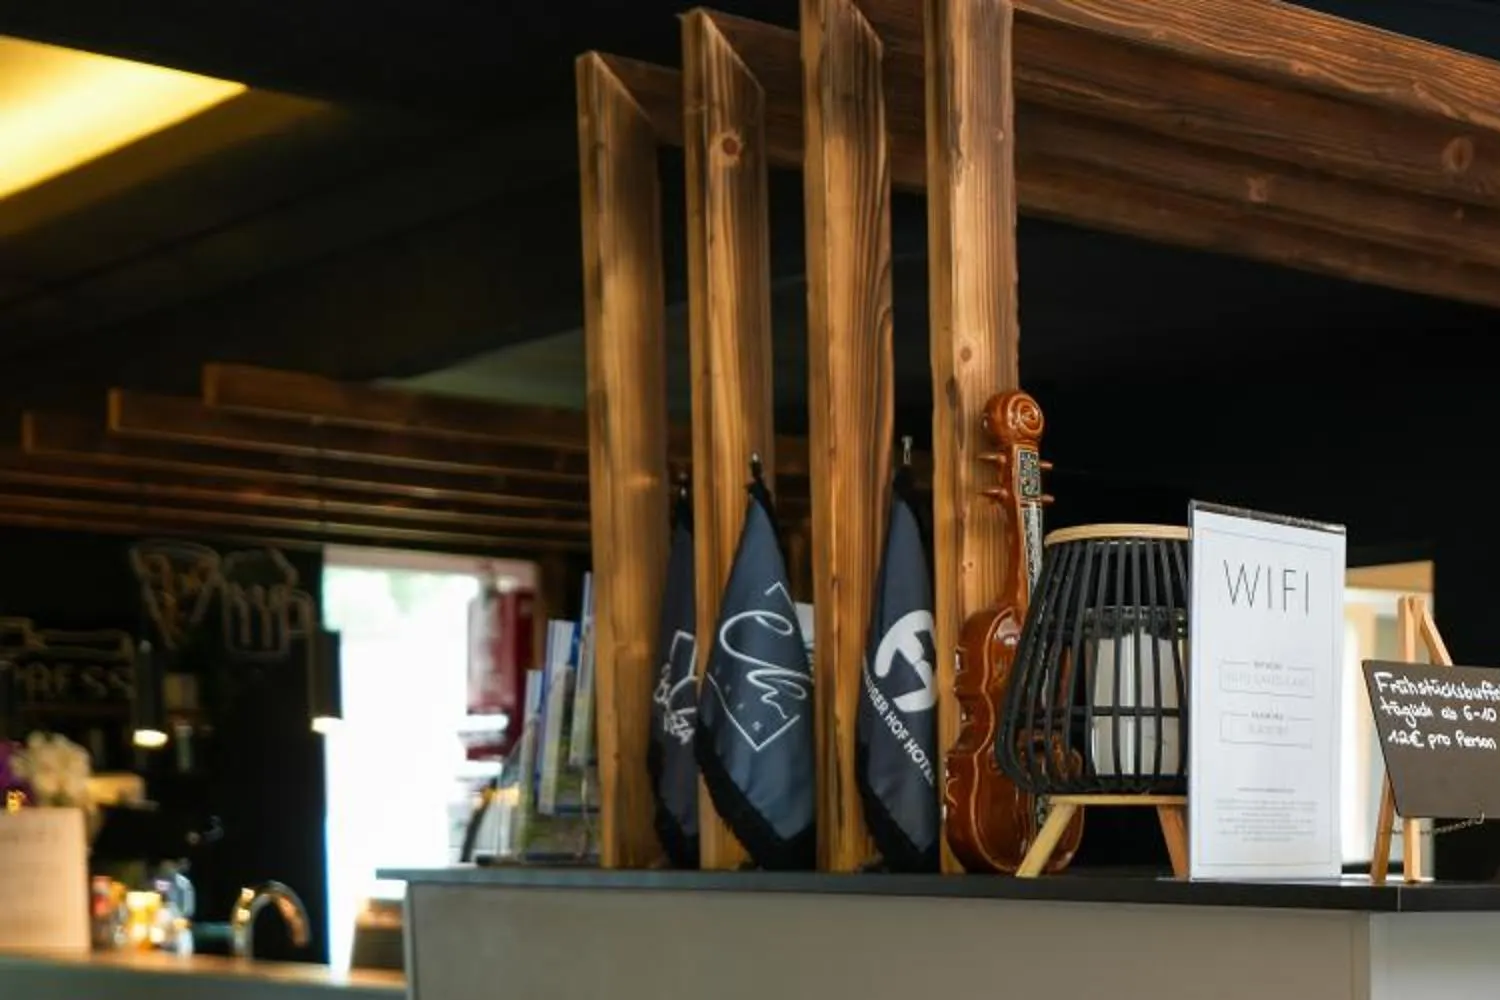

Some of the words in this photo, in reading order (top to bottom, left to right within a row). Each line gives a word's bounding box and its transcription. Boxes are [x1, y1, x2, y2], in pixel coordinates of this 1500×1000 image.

[1223, 559, 1311, 616] WIFI
[885, 710, 910, 740] HOF
[1388, 729, 1424, 748] 12€
[1427, 733, 1451, 750] pro
[1455, 729, 1497, 750] Person
